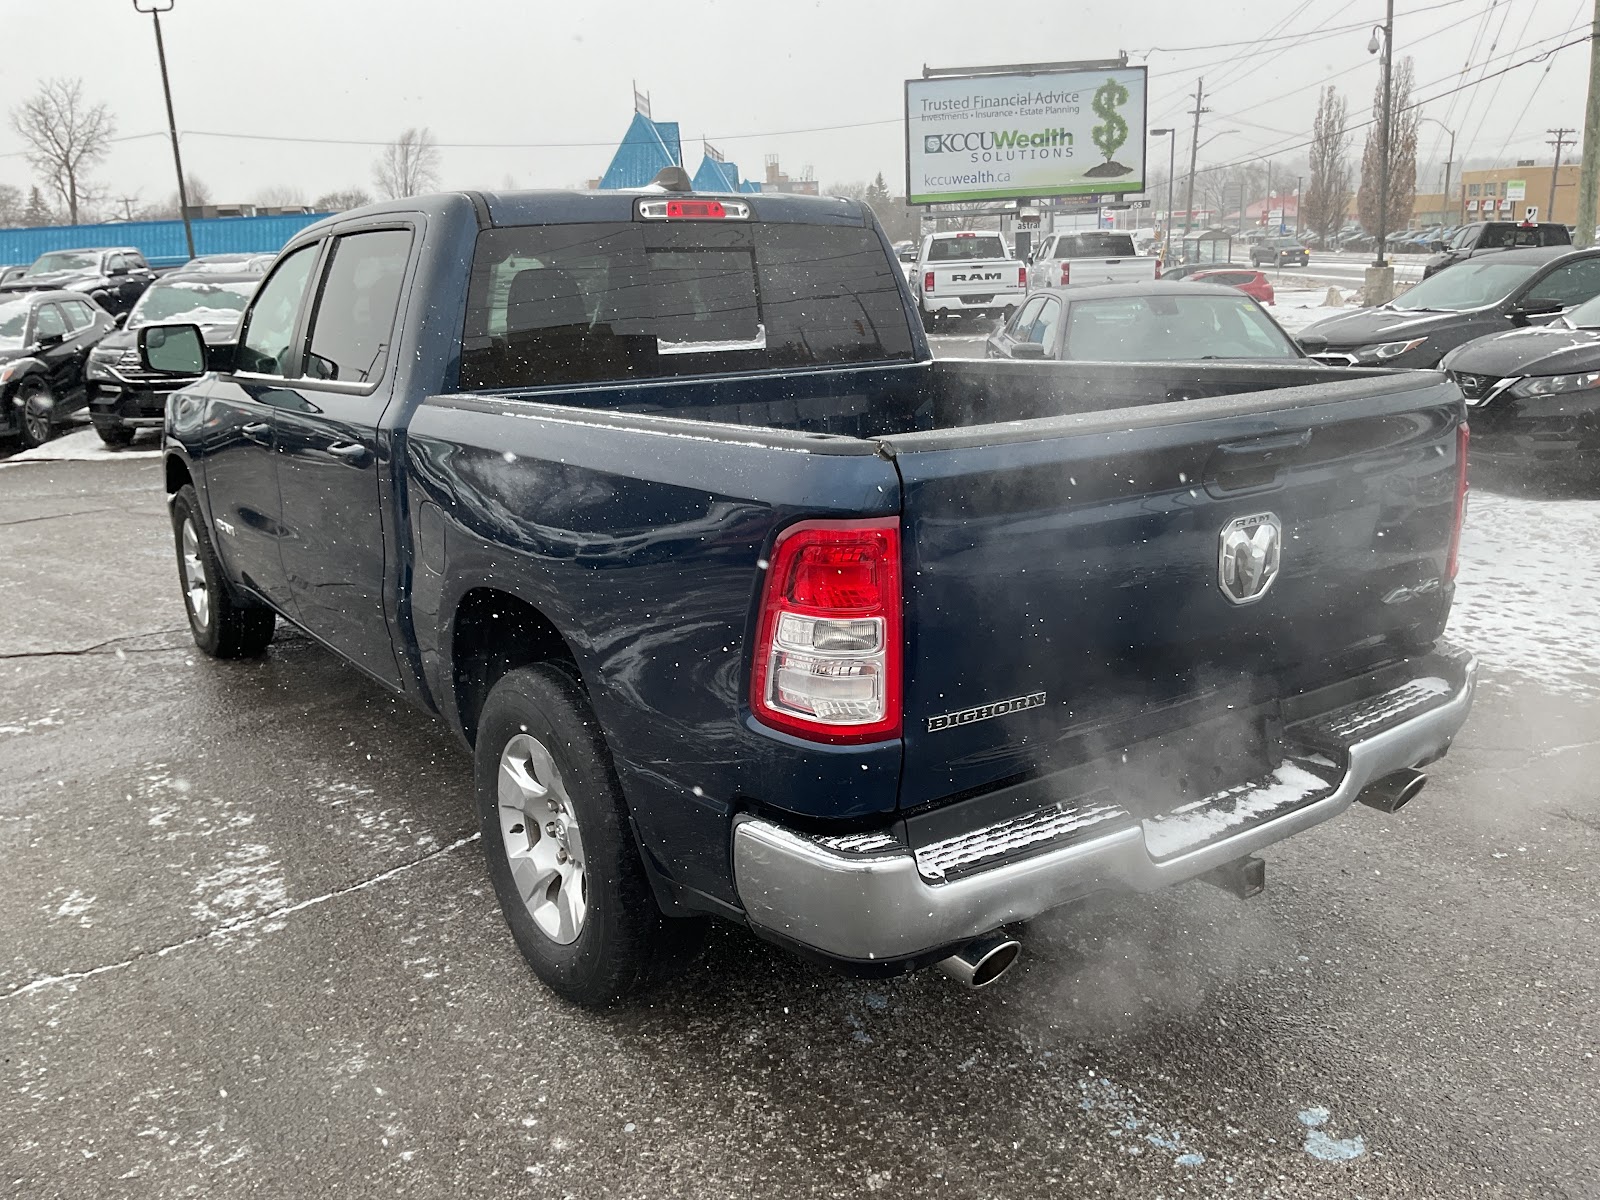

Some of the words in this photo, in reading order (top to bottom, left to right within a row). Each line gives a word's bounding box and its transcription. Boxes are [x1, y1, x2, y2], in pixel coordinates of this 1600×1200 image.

[920, 96, 970, 111] Trusted
[973, 92, 1031, 108] Financial
[1034, 90, 1079, 105] Advice
[921, 112, 969, 121] Investments
[975, 109, 1013, 119] Insurance
[1019, 107, 1043, 116] Estate
[1045, 105, 1080, 115] Planning
[970, 147, 1074, 163] SOLUTIONS
[924, 170, 1011, 187] kccuwealth.ca
[951, 272, 1002, 282] RAM
[1235, 514, 1270, 527] RAM
[927, 691, 1047, 733] BIGHORN
